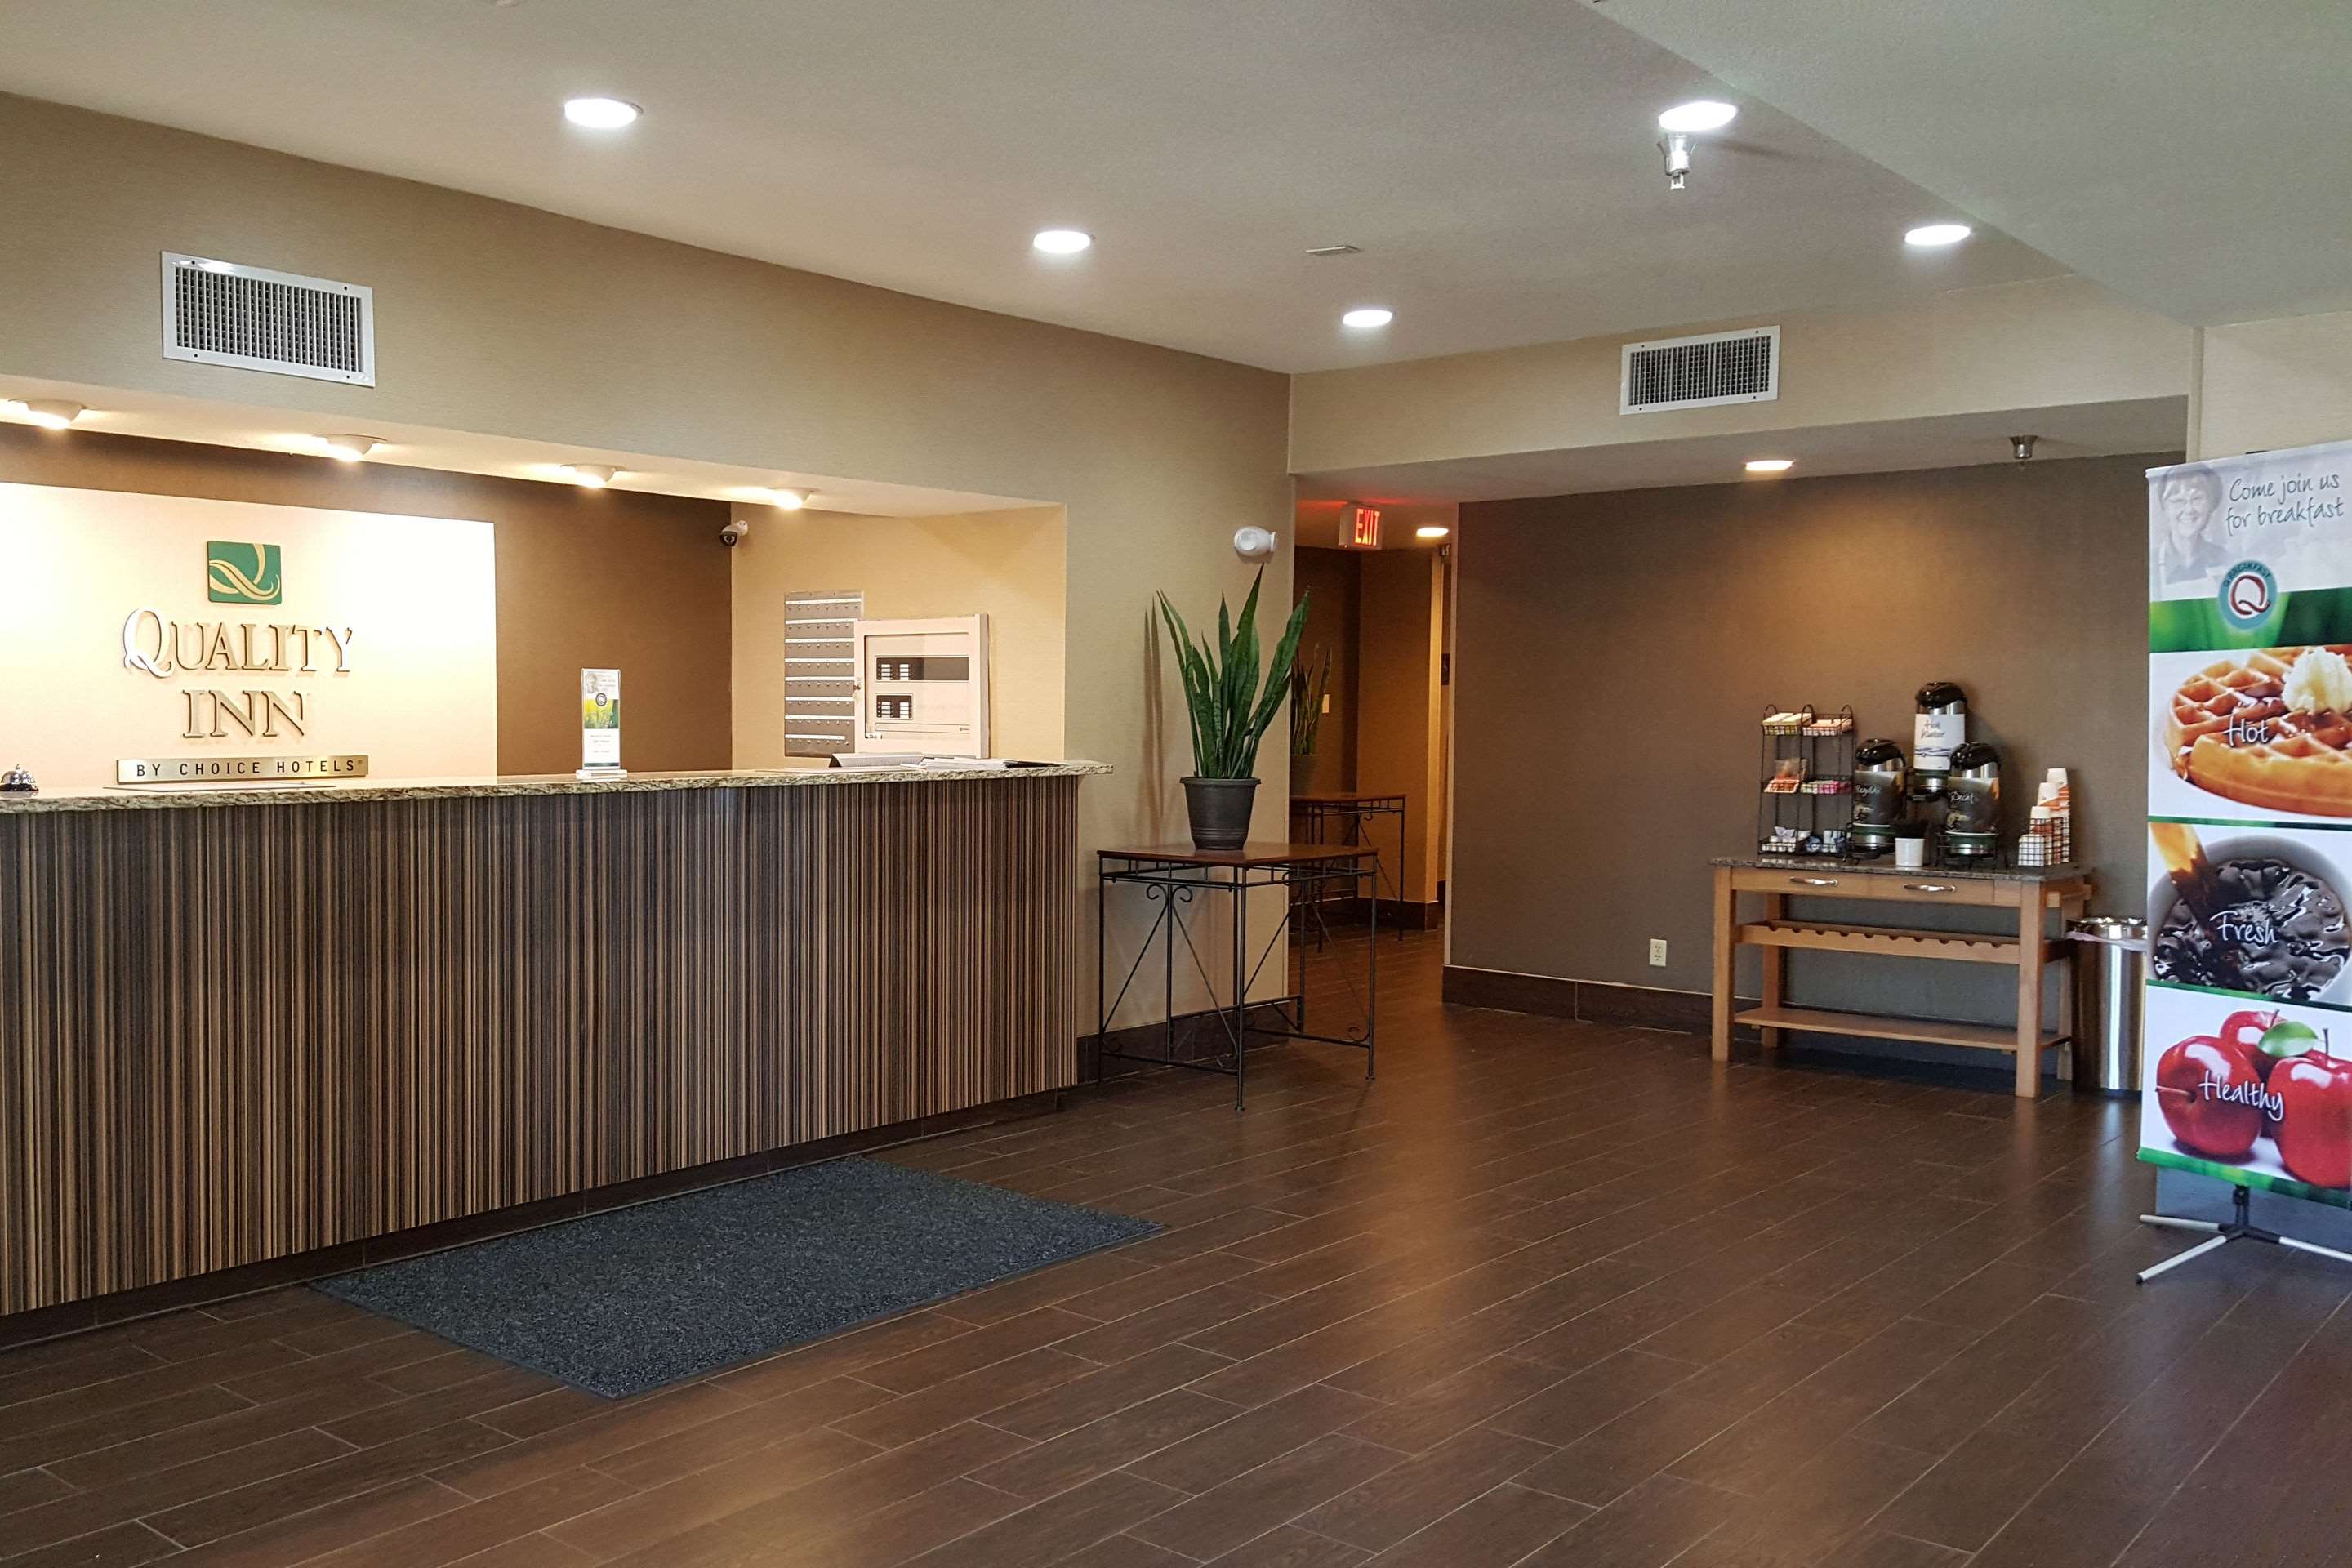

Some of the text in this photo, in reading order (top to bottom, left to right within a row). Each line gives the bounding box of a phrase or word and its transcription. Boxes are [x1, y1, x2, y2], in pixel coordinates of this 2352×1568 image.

[2229, 473, 2340, 505] Come join us
[1355, 508, 1380, 546] EXIT
[2226, 497, 2345, 536] for breakfast
[123, 608, 353, 679] QUALITY
[182, 689, 309, 739] INN
[2224, 715, 2270, 746] Hot
[136, 760, 354, 777] BY CHOICE HOTELS
[2209, 911, 2277, 944] Fresh
[2198, 1070, 2284, 1122] Healthy
